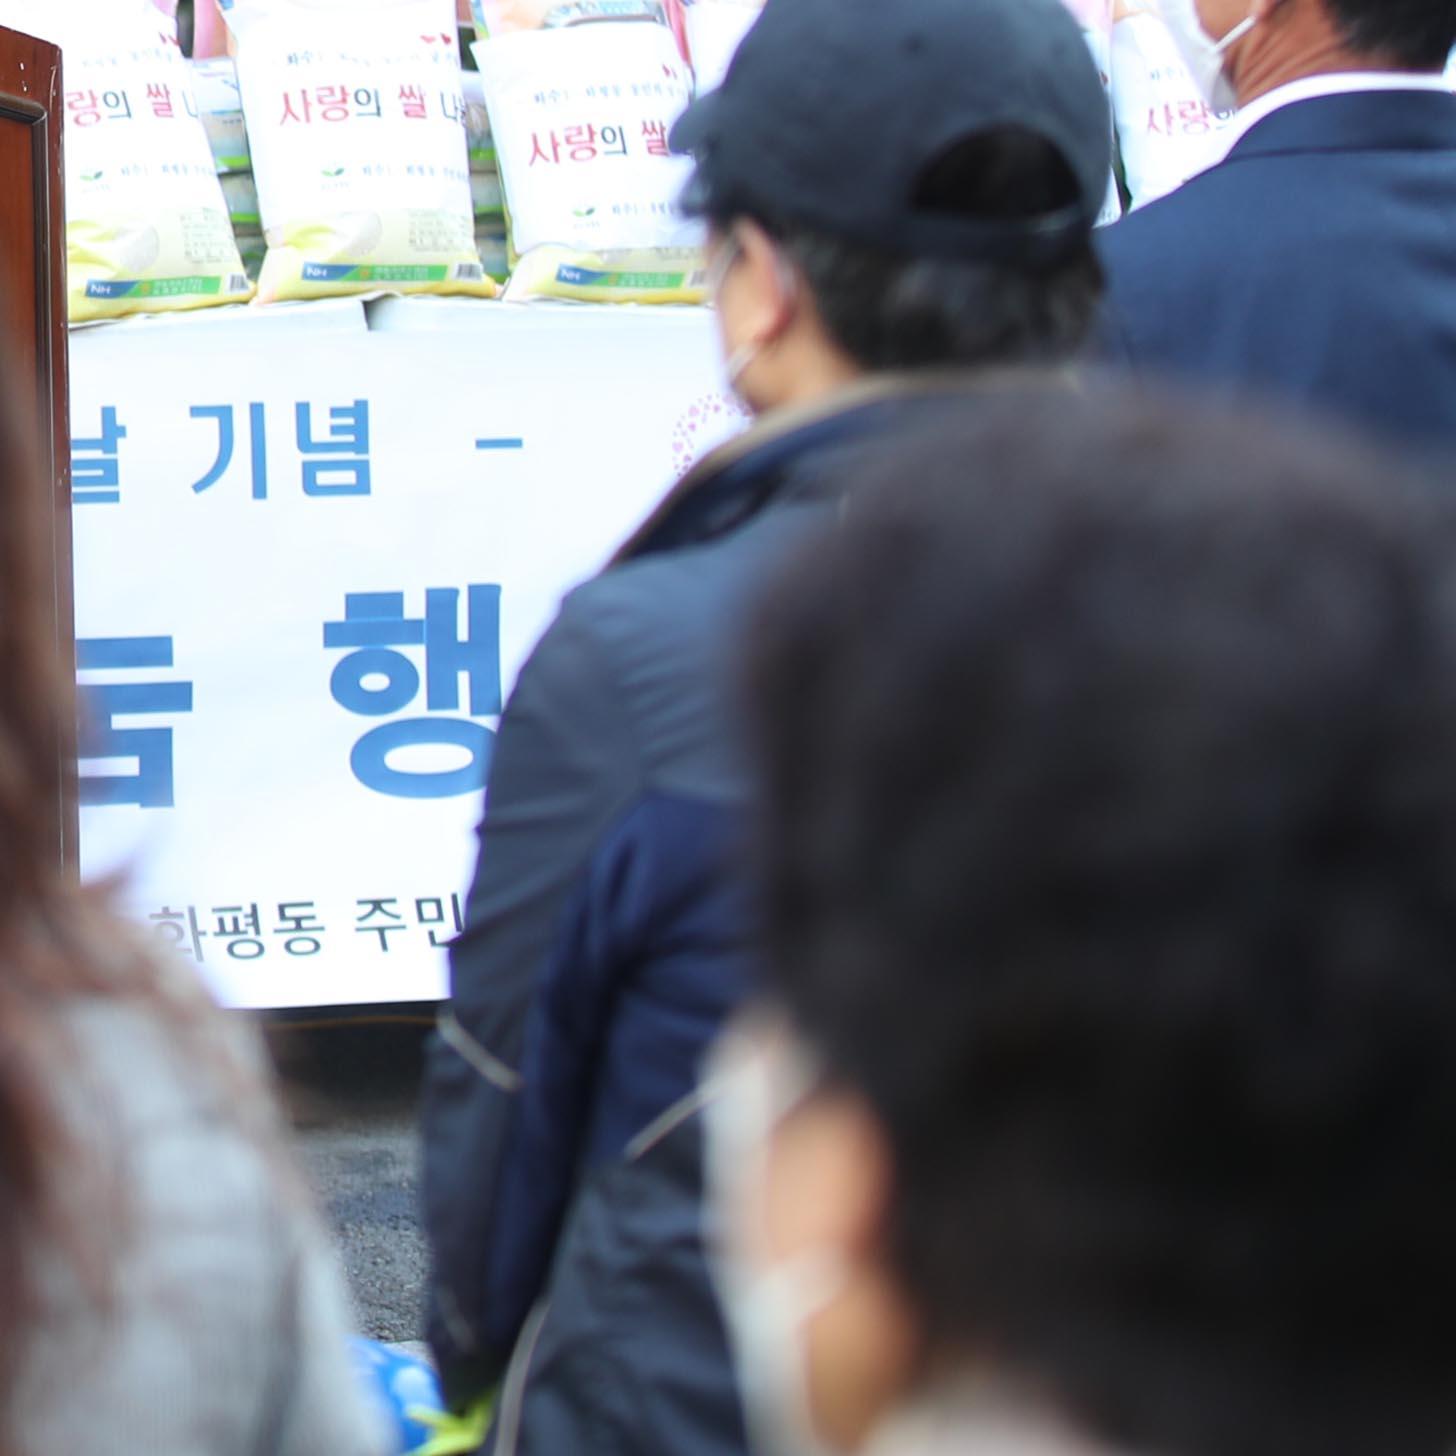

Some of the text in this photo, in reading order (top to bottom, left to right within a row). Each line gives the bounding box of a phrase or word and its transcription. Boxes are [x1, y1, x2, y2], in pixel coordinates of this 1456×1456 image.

[146, 83, 175, 118] 쌀
[280, 85, 381, 126] 사랑의
[398, 84, 427, 119] 쌀
[529, 120, 670, 166] 사랑의 쌀
[189, 399, 371, 500] 기념
[322, 583, 502, 799] 행
